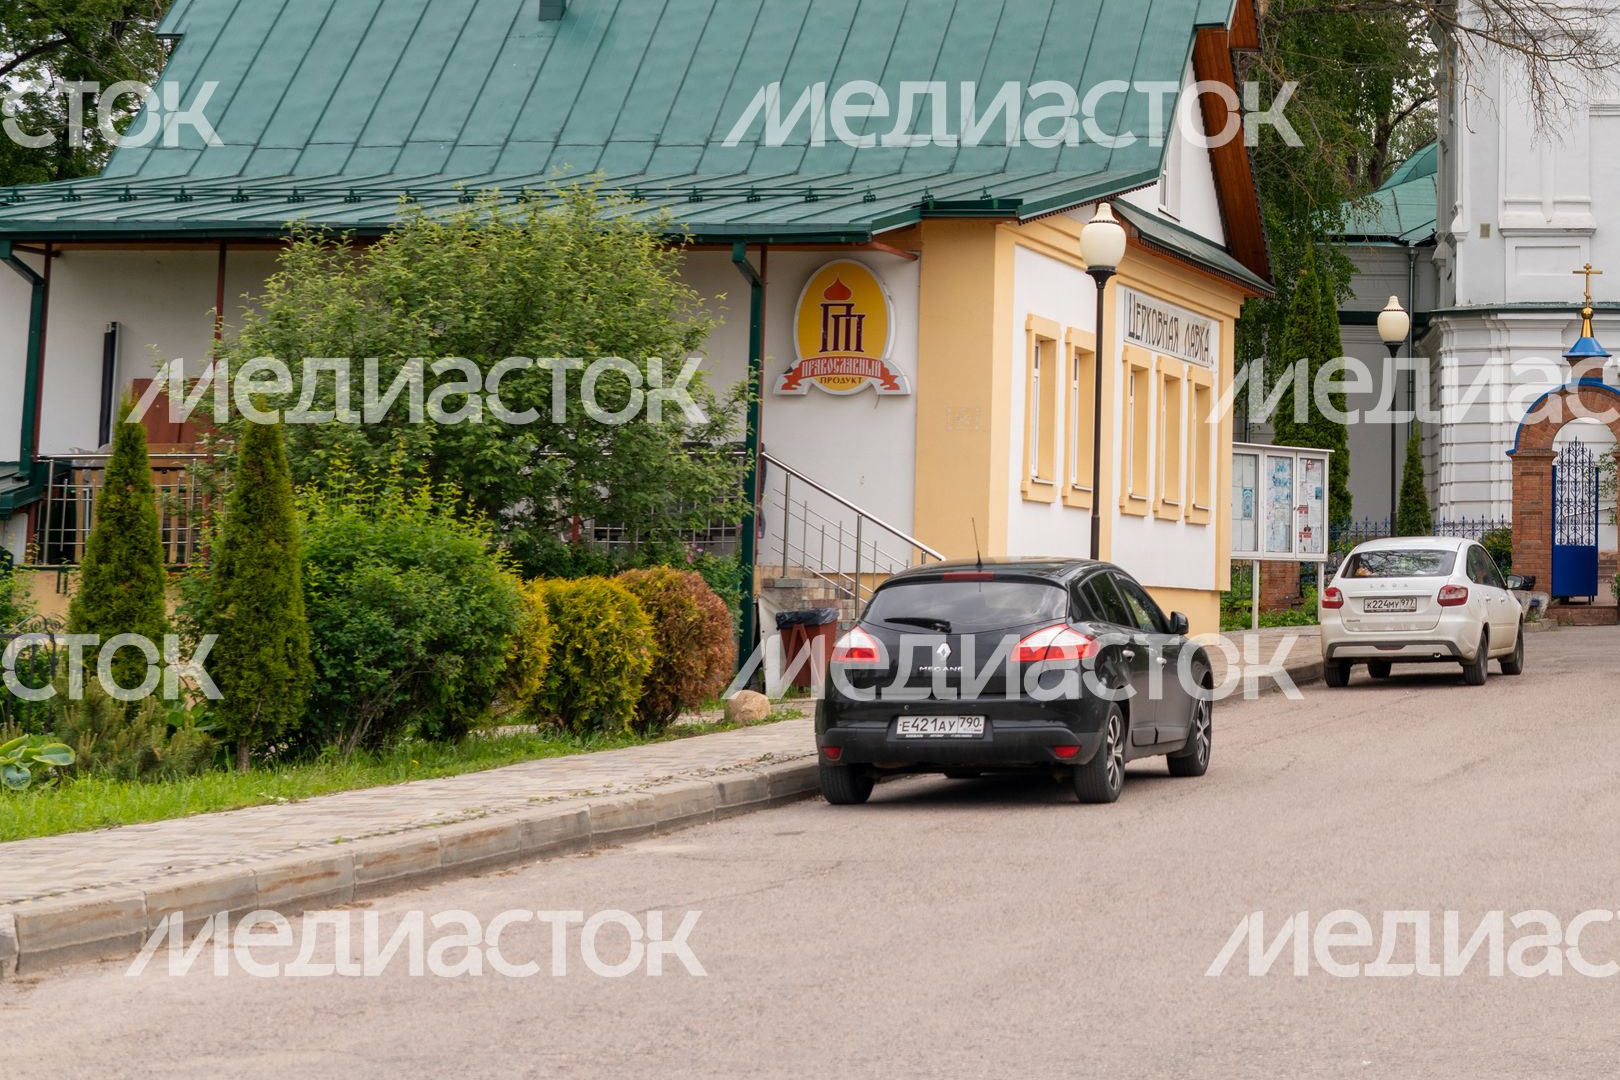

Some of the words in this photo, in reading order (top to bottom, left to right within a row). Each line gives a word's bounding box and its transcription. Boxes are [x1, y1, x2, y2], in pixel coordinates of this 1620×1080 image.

[1128, 292, 1180, 354] ЦЕРКОВНАЯ
[1184, 321, 1210, 363] ЛАВКА
[819, 376, 863, 385] ПРОДУКТ
[959, 715, 980, 728] 790
